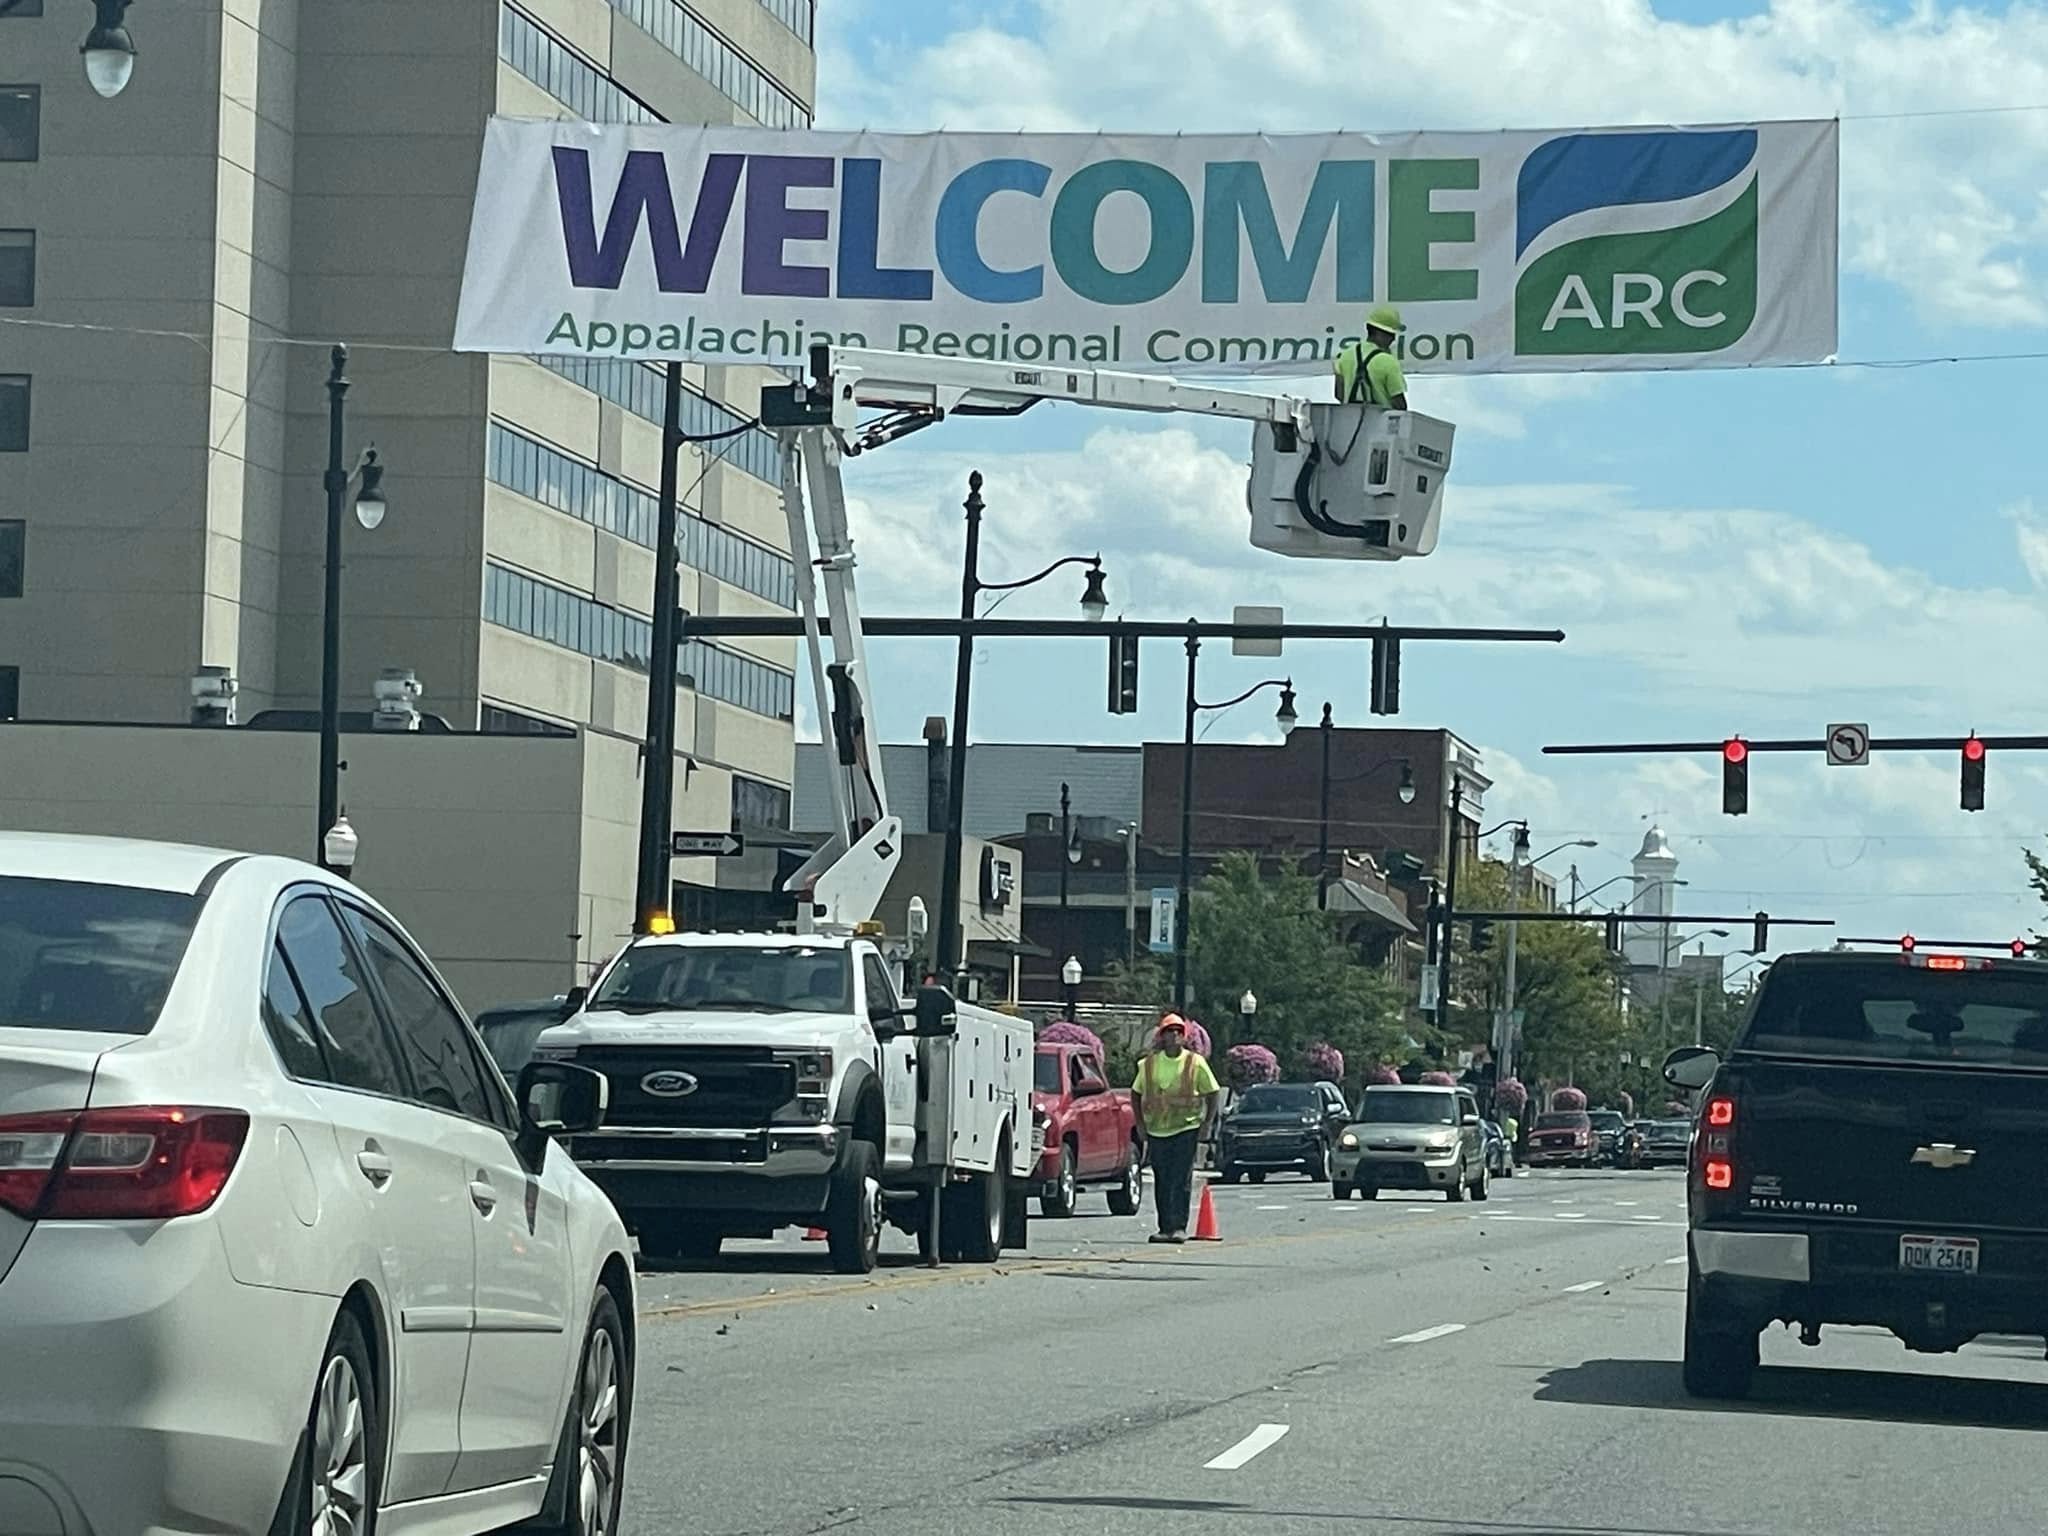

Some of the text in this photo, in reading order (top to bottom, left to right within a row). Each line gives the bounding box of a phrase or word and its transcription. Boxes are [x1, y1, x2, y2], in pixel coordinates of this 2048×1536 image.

[552, 146, 1480, 305] WELCOME
[1541, 270, 1728, 331] ARC
[898, 322, 1121, 362] Regional
[1147, 325, 1474, 362] Commision
